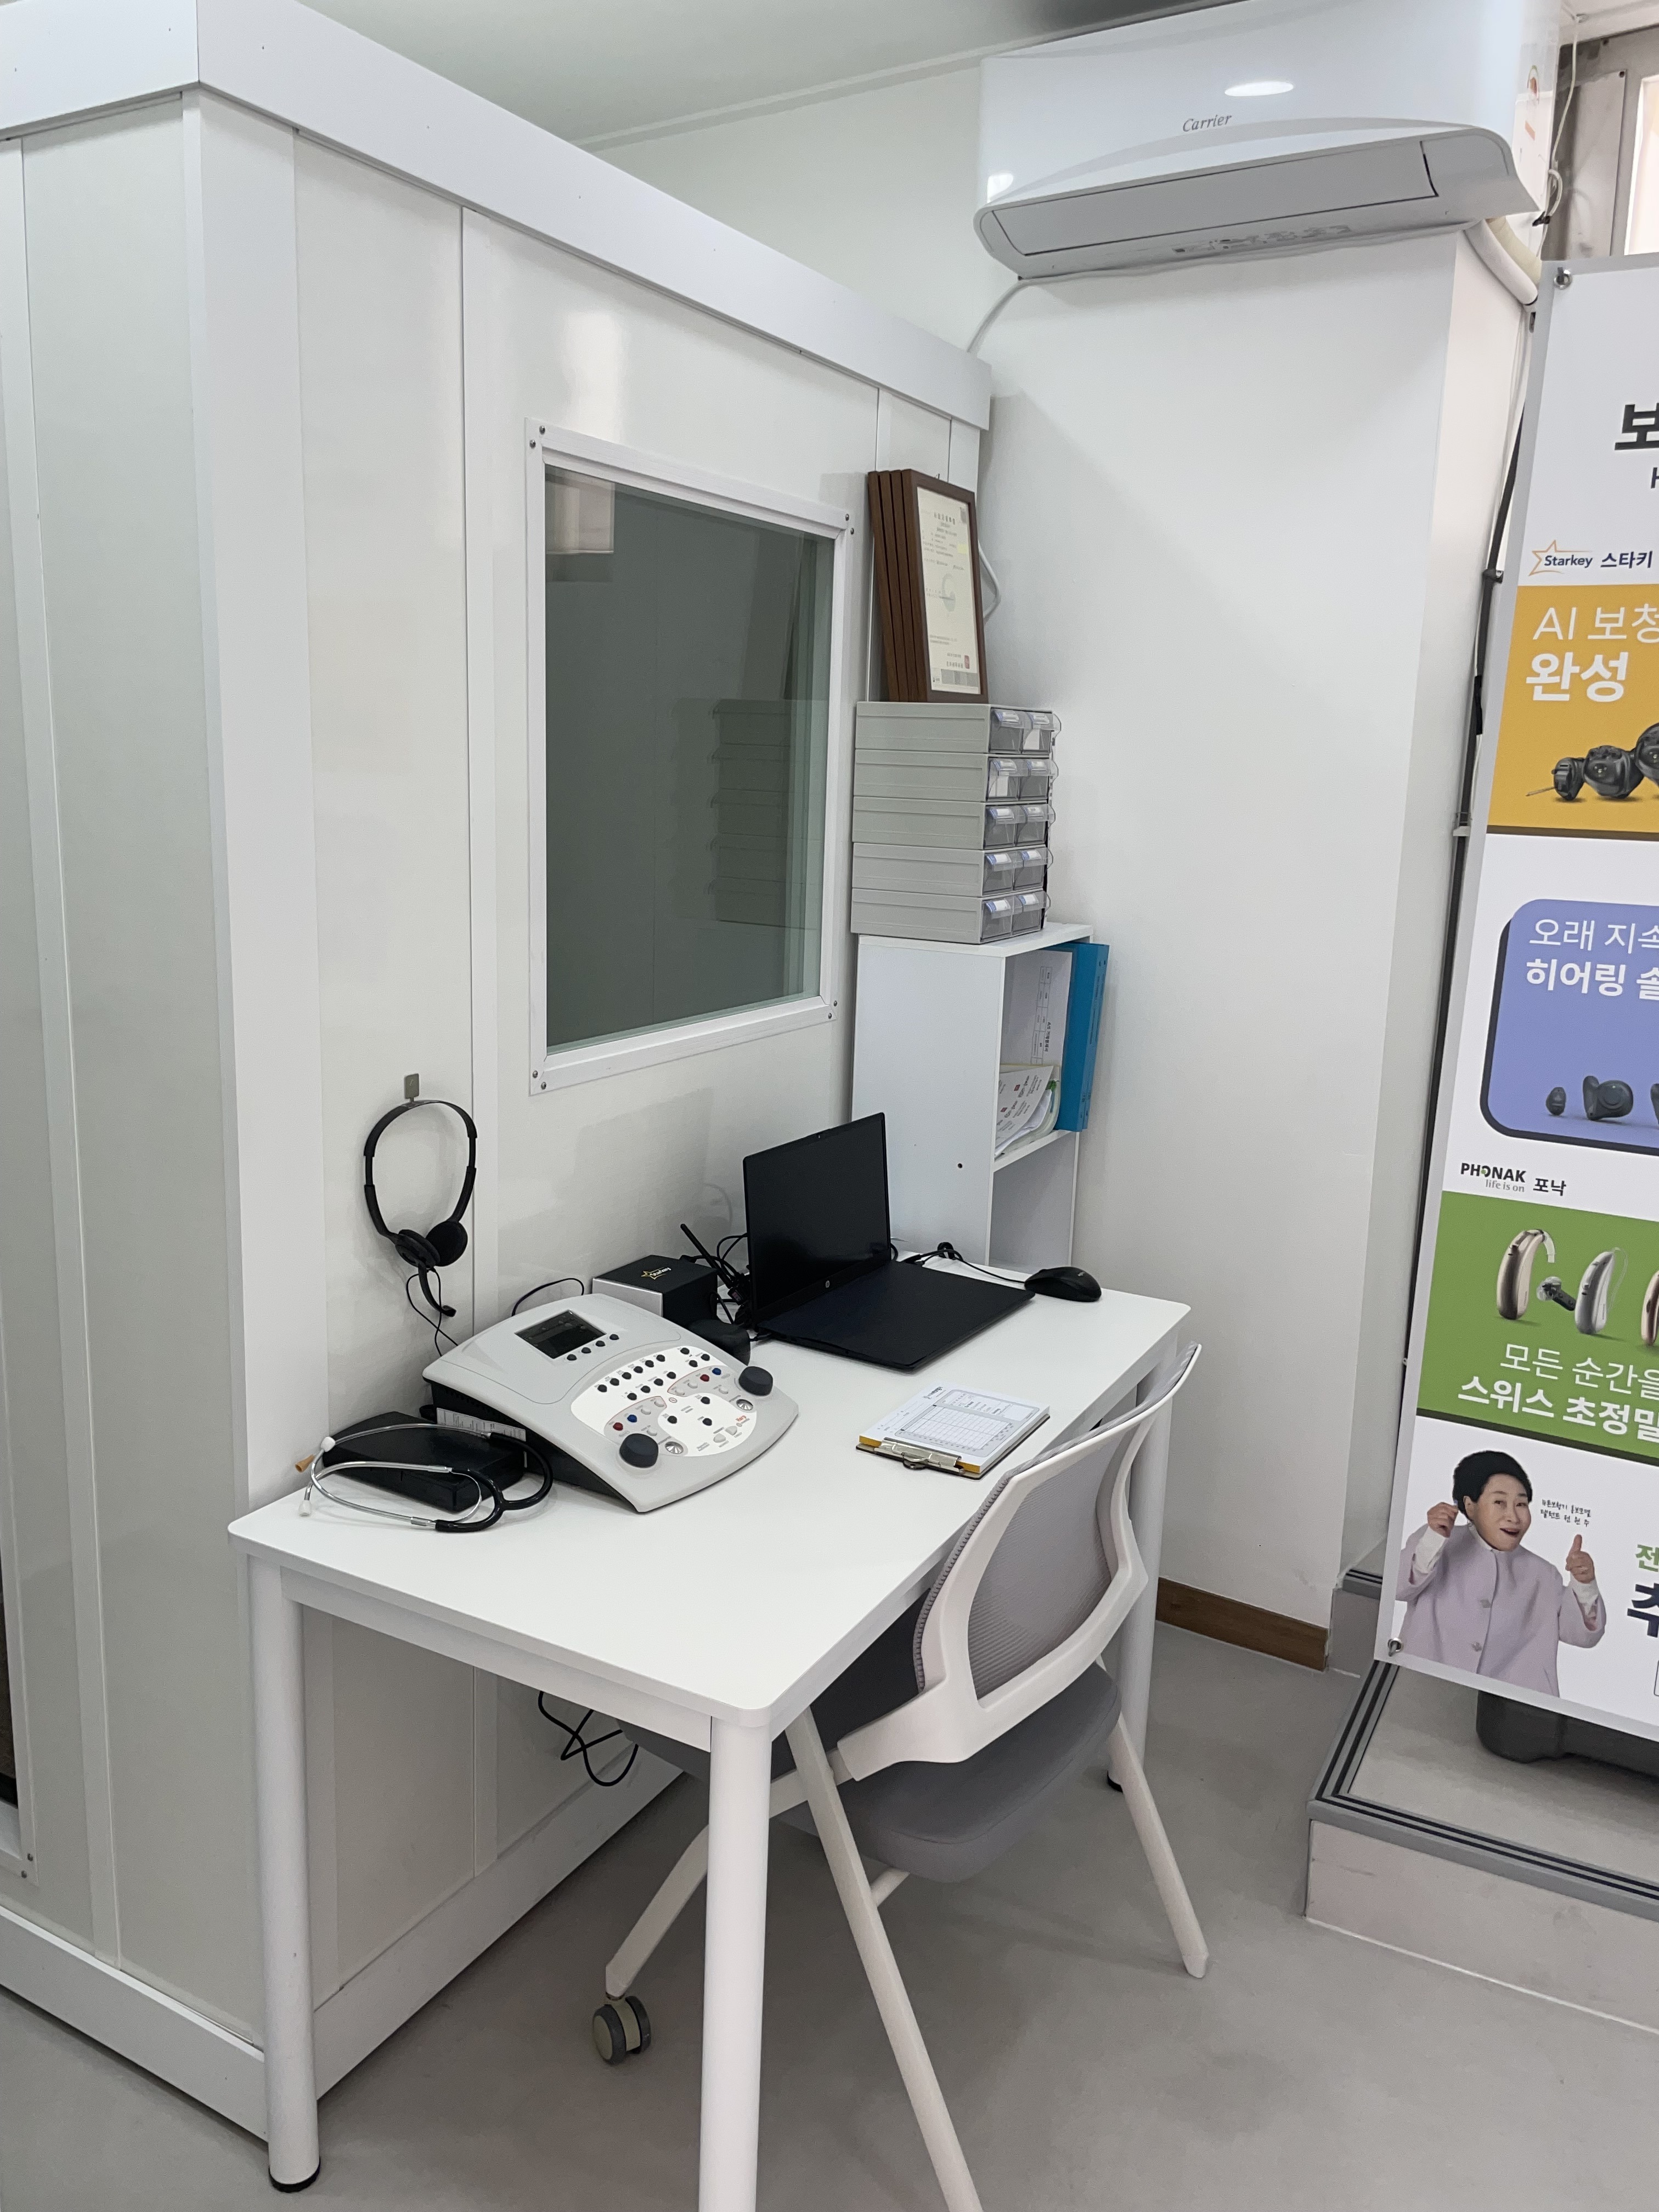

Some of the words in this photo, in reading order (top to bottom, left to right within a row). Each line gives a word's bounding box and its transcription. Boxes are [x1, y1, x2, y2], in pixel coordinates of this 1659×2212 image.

[1183, 114, 1232, 132] Carrier
[1614, 402, 1659, 451] 보
[1544, 554, 1593, 568] Starkey
[1601, 551, 1653, 568] 스타키
[1533, 607, 1576, 640] AI
[1526, 652, 1629, 702] 완성
[1529, 919, 1595, 951] 오래
[1526, 958, 1626, 997] 히어링
[1460, 1163, 1526, 1183] PHONAK
[1533, 1178, 1567, 1197] 포낙
[1486, 1179, 1500, 1189] life
[1503, 1182, 1510, 1190] is
[1500, 1344, 1564, 1380] 모든
[1572, 1357, 1659, 1401] 순간을
[1458, 1376, 1554, 1418] 스위스
[1562, 1397, 1659, 1443] 초정밀
